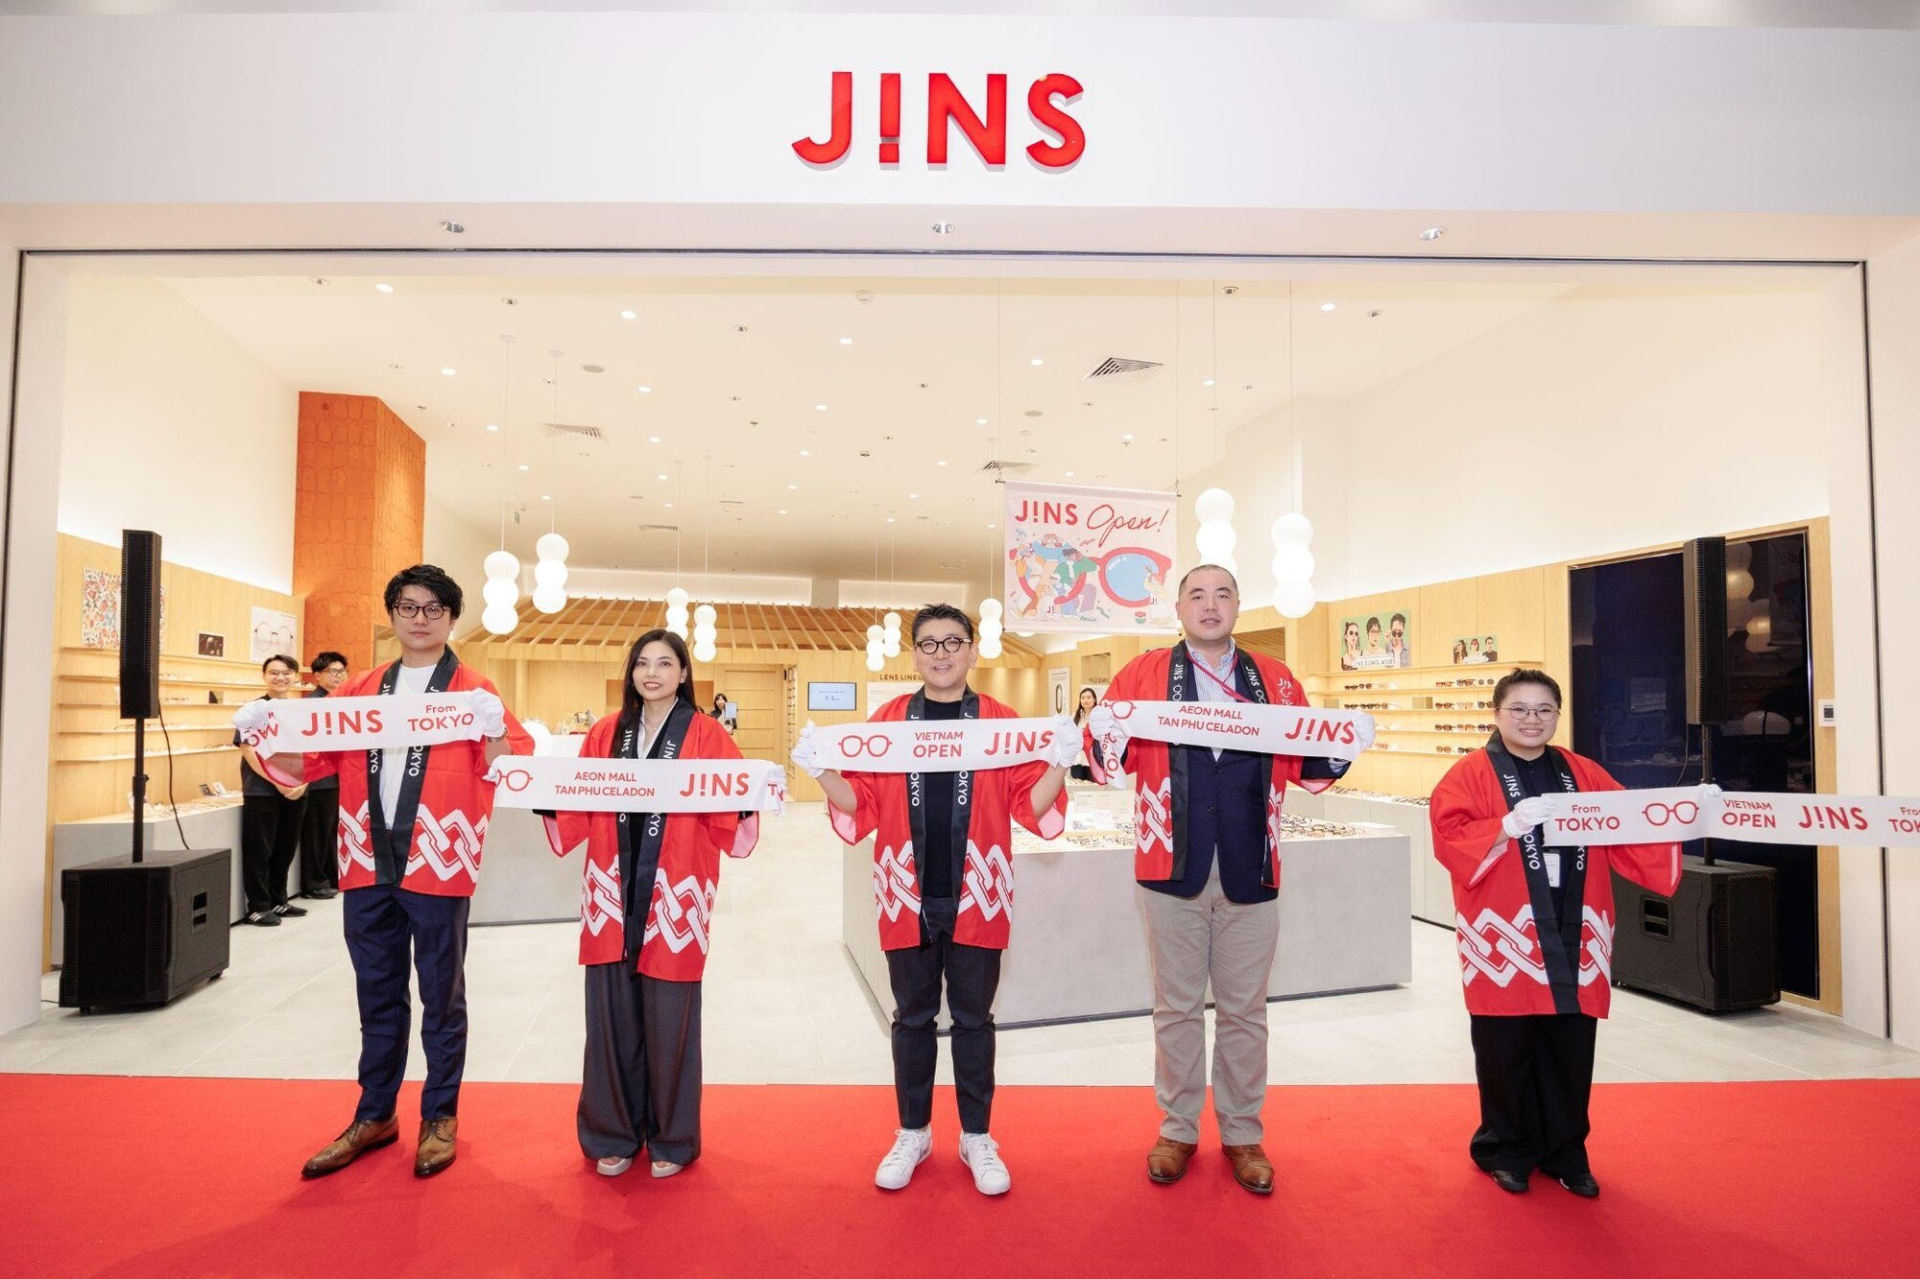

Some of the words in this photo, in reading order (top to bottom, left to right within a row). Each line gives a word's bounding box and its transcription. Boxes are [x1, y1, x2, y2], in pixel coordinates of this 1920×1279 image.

[1085, 503, 1169, 548] Open!
[879, 673, 899, 681] LENS
[425, 704, 457, 714] From
[1178, 705, 1212, 717] AEON
[1213, 708, 1243, 720] MALL
[407, 712, 475, 732] TOKYO
[1157, 716, 1180, 727] TAN
[1180, 719, 1205, 730] PHU
[1206, 722, 1260, 736] CELADON
[915, 731, 964, 742] VIETNAM
[912, 744, 963, 758] OPEN
[574, 771, 606, 782] AEON
[608, 772, 637, 782] MALL
[554, 784, 577, 795] TAN
[577, 786, 601, 796] PHU
[602, 786, 655, 797] CELADON
[1571, 804, 1601, 813] From
[1723, 799, 1773, 810] VIETNAM
[1900, 806, 1920, 816] Fro
[1554, 816, 1620, 831] TOKYO
[1721, 812, 1777, 829] OPEN
[1888, 818, 1920, 833] TOK
